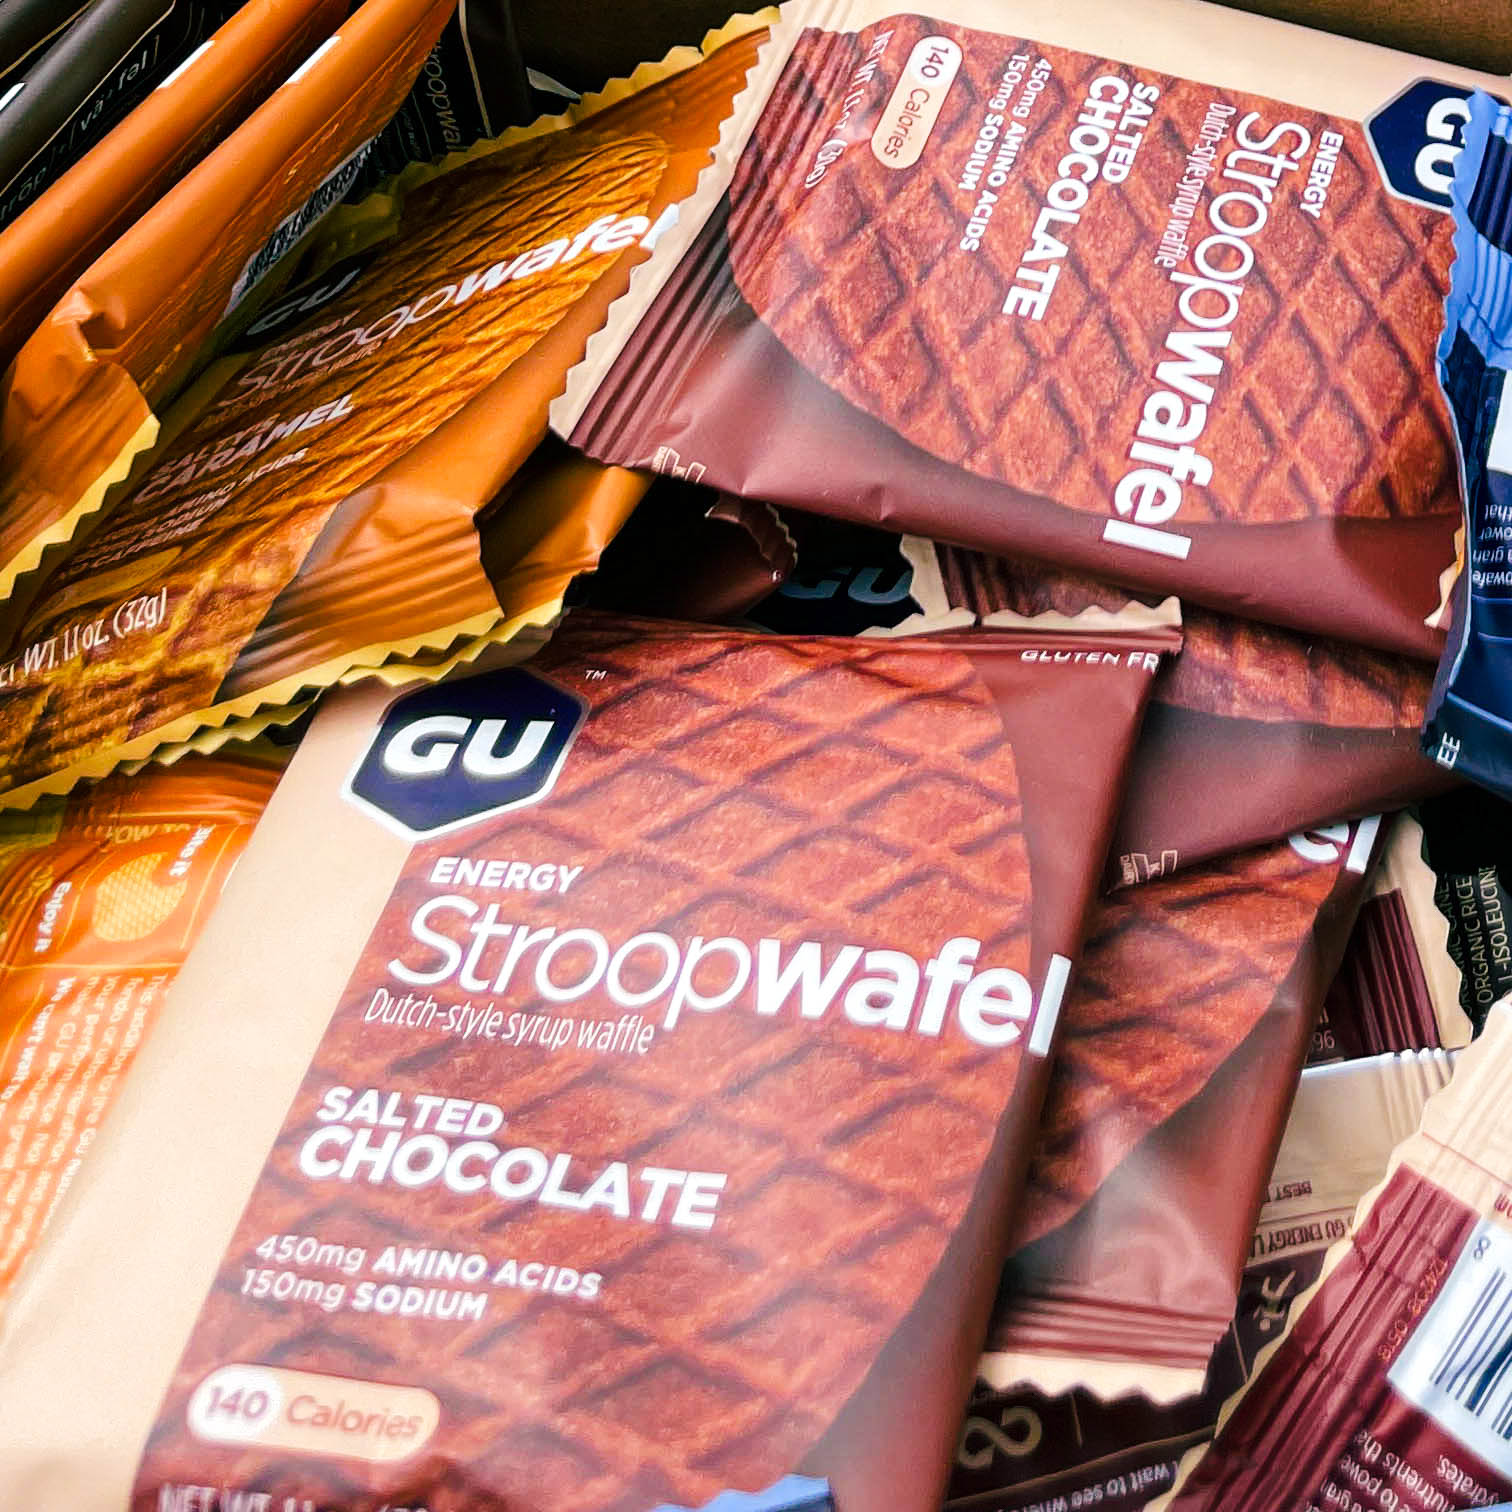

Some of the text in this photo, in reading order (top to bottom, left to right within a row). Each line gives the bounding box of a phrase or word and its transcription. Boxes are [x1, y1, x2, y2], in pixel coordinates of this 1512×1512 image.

[884, 43, 950, 160] 140 Calories
[957, 53, 1031, 192] 150mg SODIUM
[1101, 81, 1161, 185] SALTED
[1414, 96, 1473, 194] GU
[959, 57, 1053, 253] 450mg AMINO ACIDS
[1001, 74, 1131, 322] CHOCOLATE
[1153, 103, 1237, 269] Dutch-style syrup waffle
[1300, 129, 1344, 219] ENERGY
[237, 202, 681, 406] Stroopwafel
[1103, 111, 1313, 561] Stroopwafel
[133, 393, 354, 506] CARAMEL
[112, 587, 168, 640] (32g)
[1019, 648, 1122, 671] GLUTEN
[382, 713, 559, 776] GU
[428, 855, 583, 894] ENERGY
[387, 893, 1073, 1060] Stroopwafel
[1455, 875, 1495, 1005] ORGANIC RICE
[363, 985, 656, 1057] Dutch-style syrup waffle
[315, 1086, 505, 1136] SALTED
[296, 1124, 729, 1232] CHOCOLATE
[255, 1231, 603, 1301] 450mg AMINO ACIDS
[1269, 1223, 1320, 1255] ENERGY
[1473, 1235, 1490, 1261] 8
[239, 1267, 490, 1322] 150mg SODIUM
[205, 1385, 425, 1443] 140 Calories
